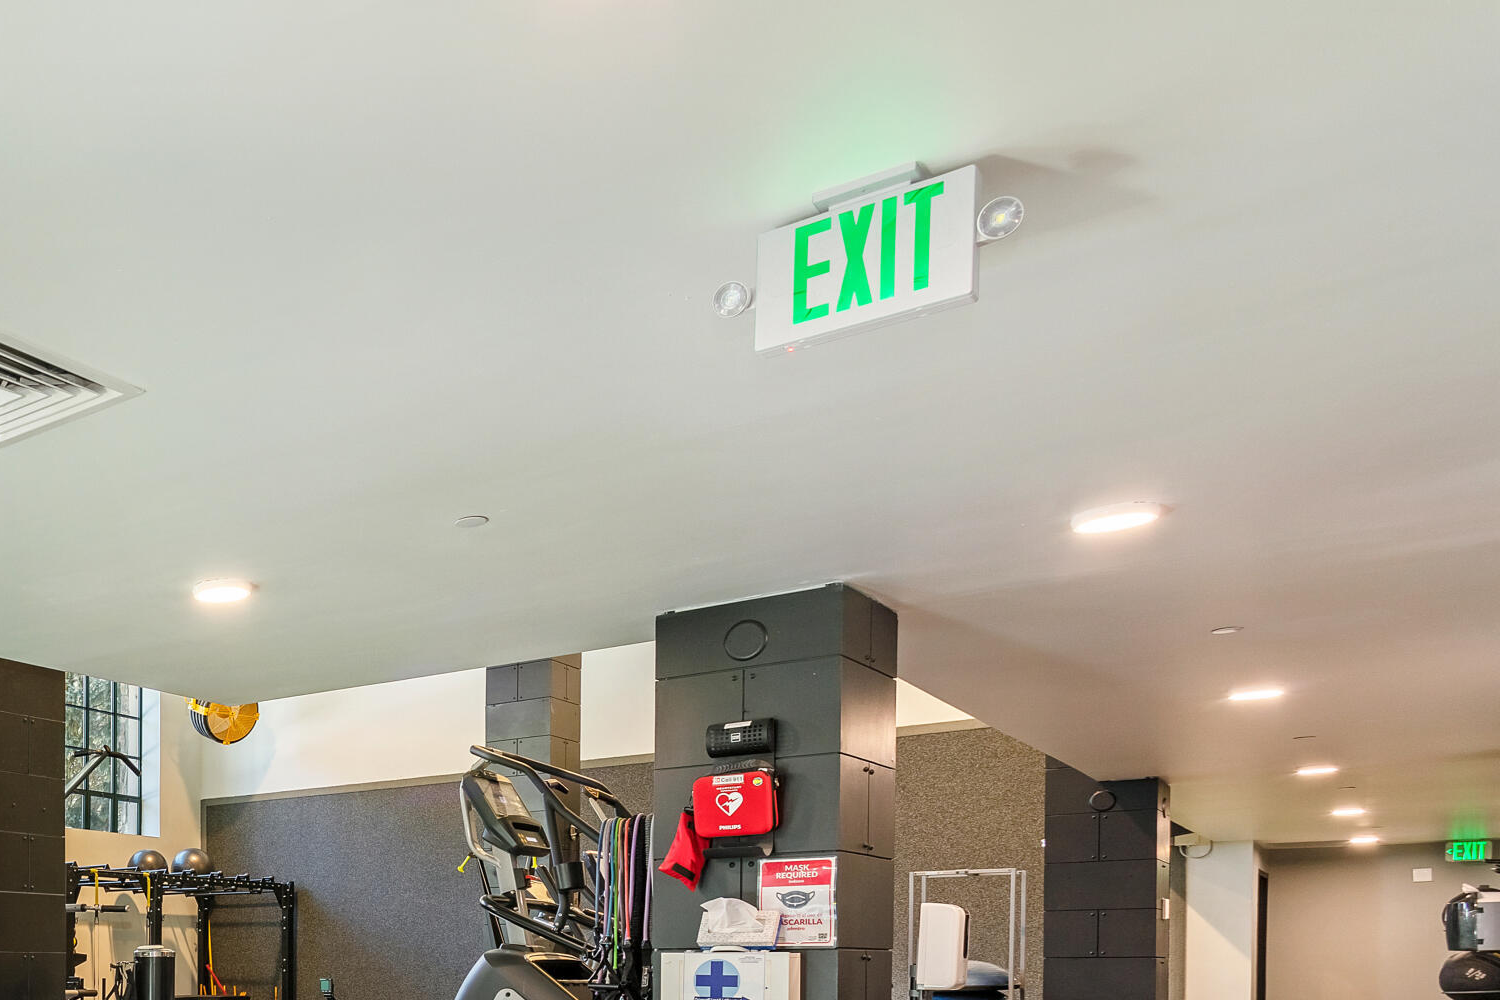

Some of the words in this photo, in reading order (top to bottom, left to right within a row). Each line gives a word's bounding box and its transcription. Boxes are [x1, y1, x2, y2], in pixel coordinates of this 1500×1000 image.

[793, 181, 944, 324] EXIT
[1453, 841, 1487, 861] EXIT
[776, 871, 818, 879] REQUIRED
[781, 918, 823, 926] SCARILLA
